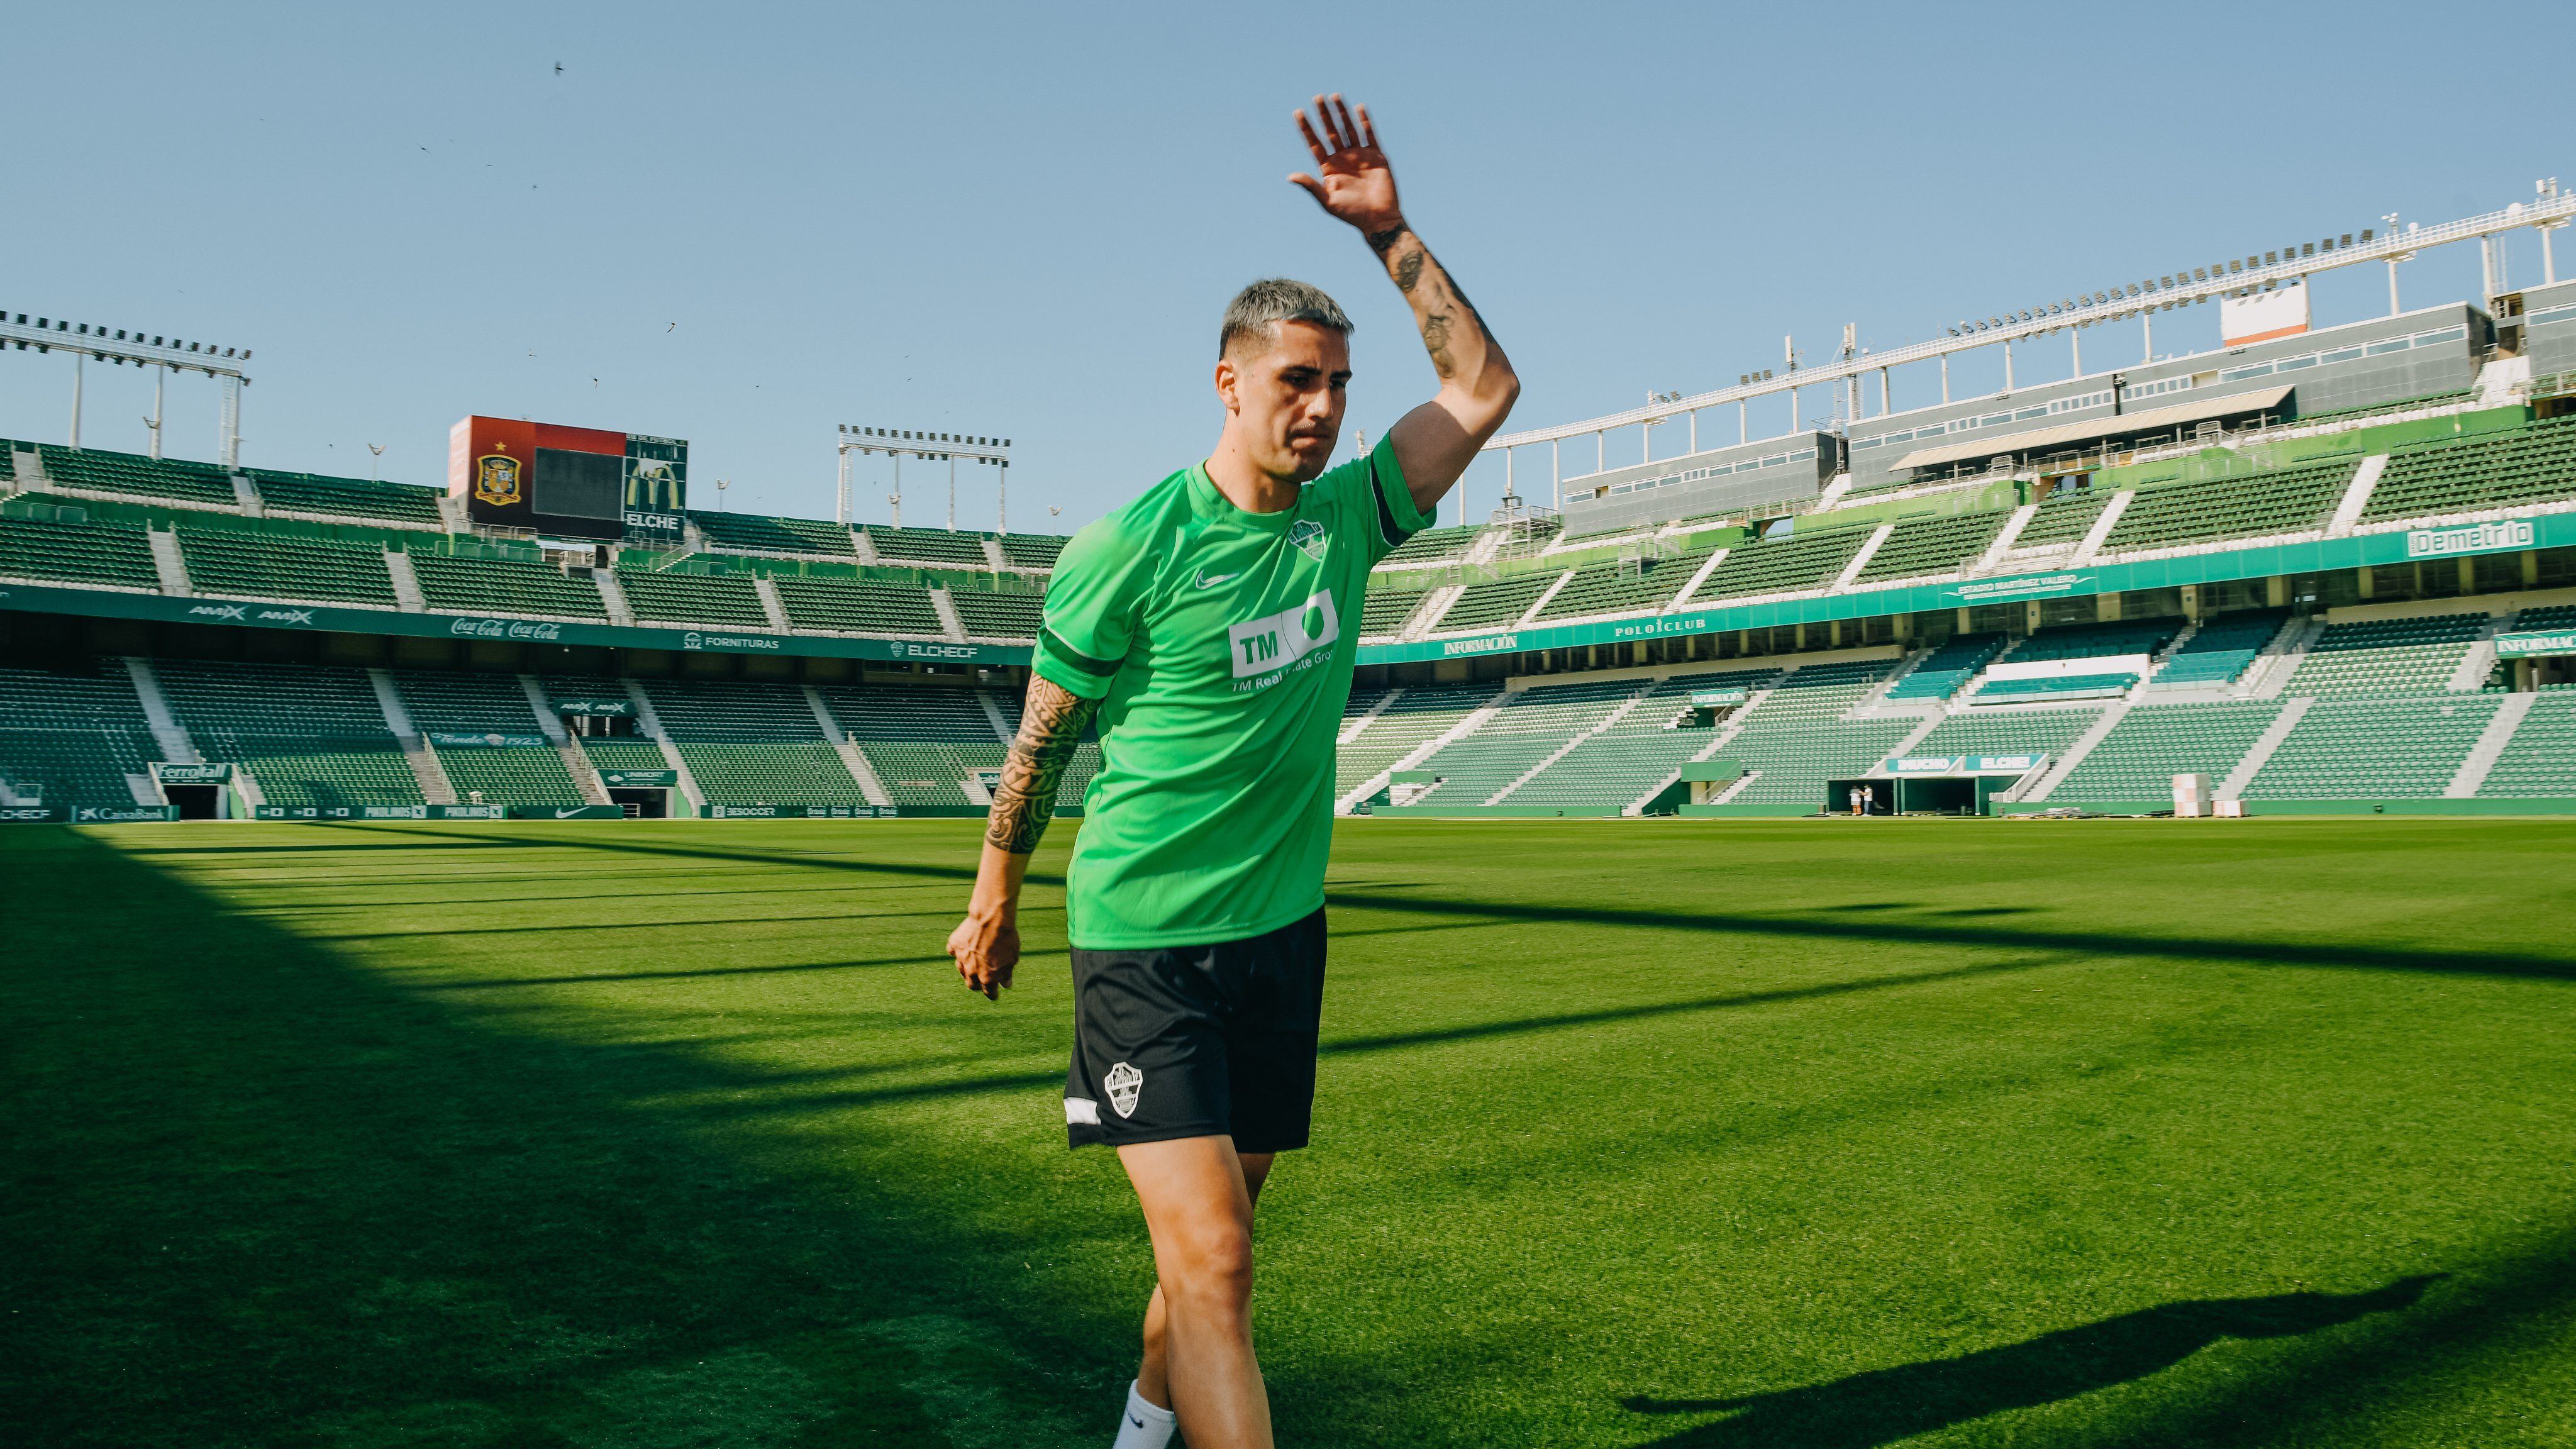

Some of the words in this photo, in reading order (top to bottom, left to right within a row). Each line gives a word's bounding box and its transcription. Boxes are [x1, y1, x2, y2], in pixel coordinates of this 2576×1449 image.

[626, 514, 679, 530] ELCHE
[2418, 524, 2528, 552] Demetrio
[1958, 583, 1994, 594] ESTADIO
[2040, 574, 2077, 585] VALERO
[1615, 625, 1655, 637] POLO
[1664, 619, 1706, 631] CLUB
[705, 637, 779, 649] FORNITURAS
[908, 645, 977, 658] ELCHECF
[1239, 631, 1278, 665] TM
[1444, 633, 1518, 655] INFORMACIÓN
[1233, 680, 1252, 692] TM
[1255, 670, 1282, 689] Real
[506, 737, 543, 745] 1923
